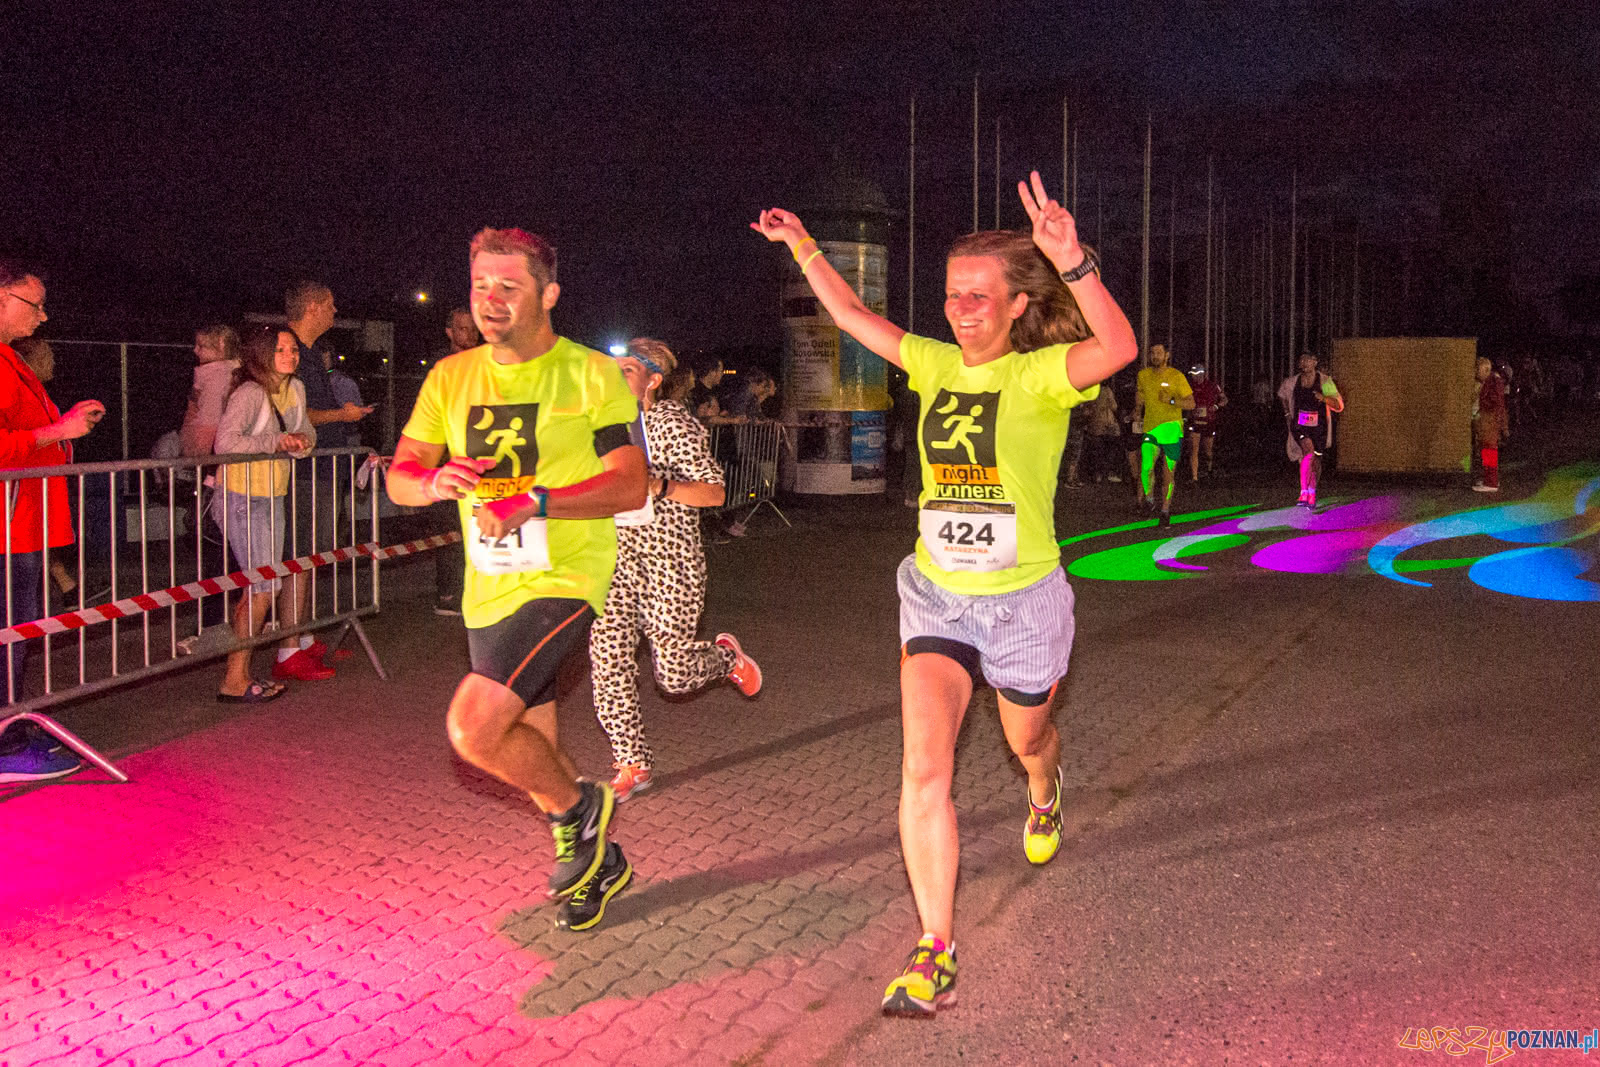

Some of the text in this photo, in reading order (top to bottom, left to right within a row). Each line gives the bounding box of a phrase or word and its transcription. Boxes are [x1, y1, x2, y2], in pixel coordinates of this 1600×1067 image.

[943, 464, 989, 483] night
[935, 484, 1004, 499] runners
[938, 521, 995, 546] 424
